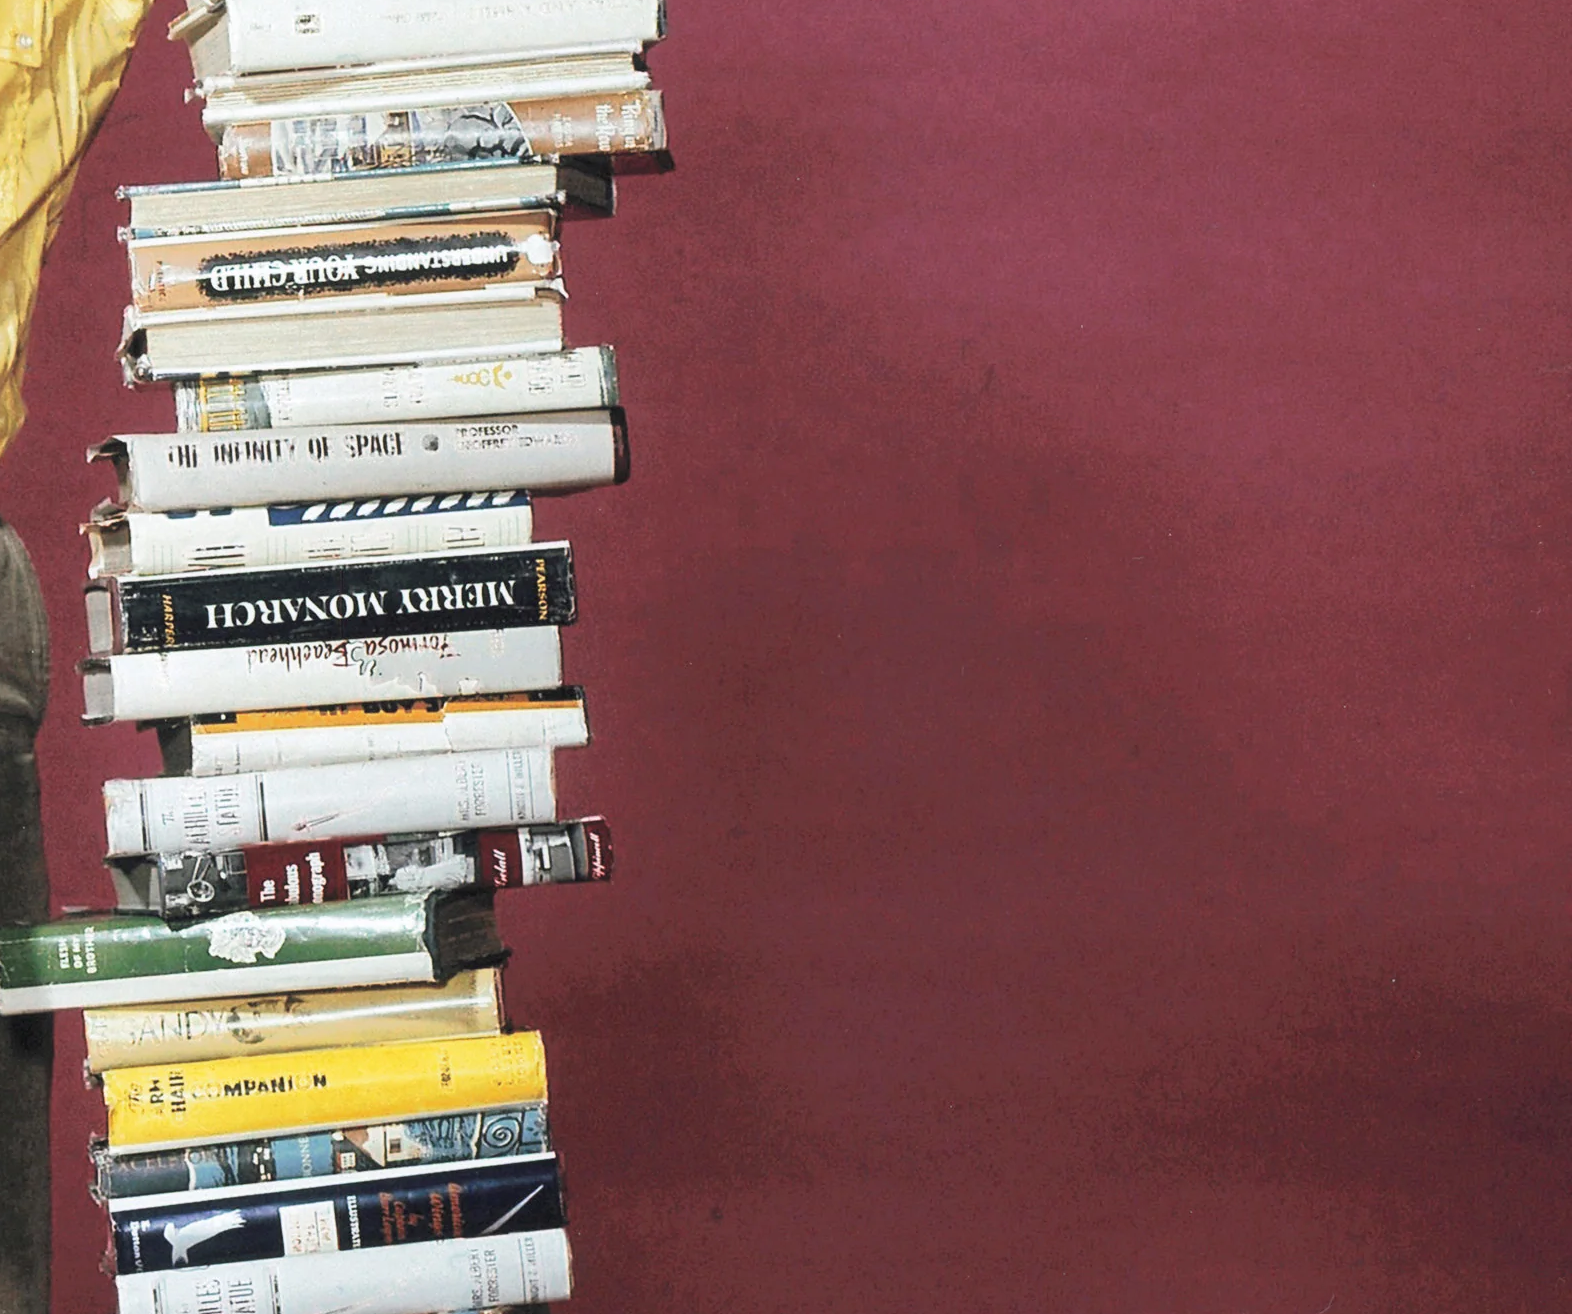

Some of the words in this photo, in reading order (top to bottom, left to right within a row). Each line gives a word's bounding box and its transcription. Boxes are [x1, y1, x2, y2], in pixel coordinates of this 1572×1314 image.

[293, 253, 361, 287] YOUR
[364, 244, 509, 273] UNDERSTANDING
[210, 261, 288, 292] CHILD
[214, 438, 296, 466] INFINITY
[308, 437, 332, 462] OF
[343, 431, 404, 459] SPACE
[397, 579, 517, 615] MERRY
[534, 557, 548, 621] PEARSON
[204, 588, 391, 629] MONARCH
[261, 878, 276, 903] The
[86, 926, 97, 973] BROTHER
